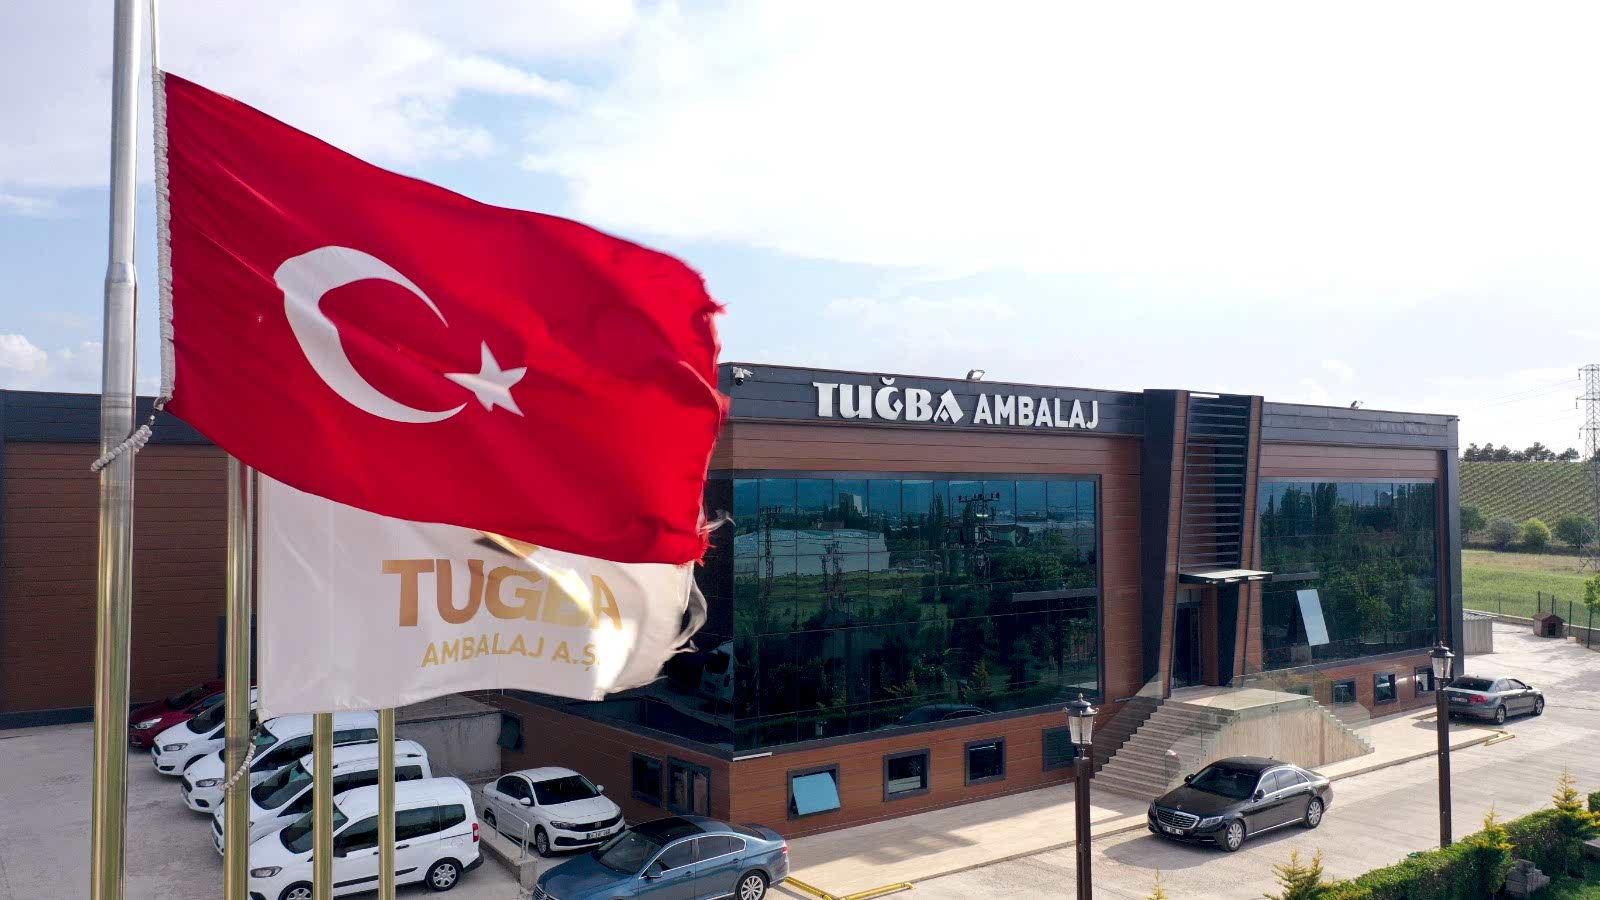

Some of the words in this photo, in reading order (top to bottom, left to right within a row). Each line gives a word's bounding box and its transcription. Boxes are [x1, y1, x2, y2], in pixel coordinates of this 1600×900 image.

[812, 377, 964, 424] TUĞBA
[973, 393, 1099, 429] AMBALAJ
[421, 632, 544, 667] AMBALAJ
